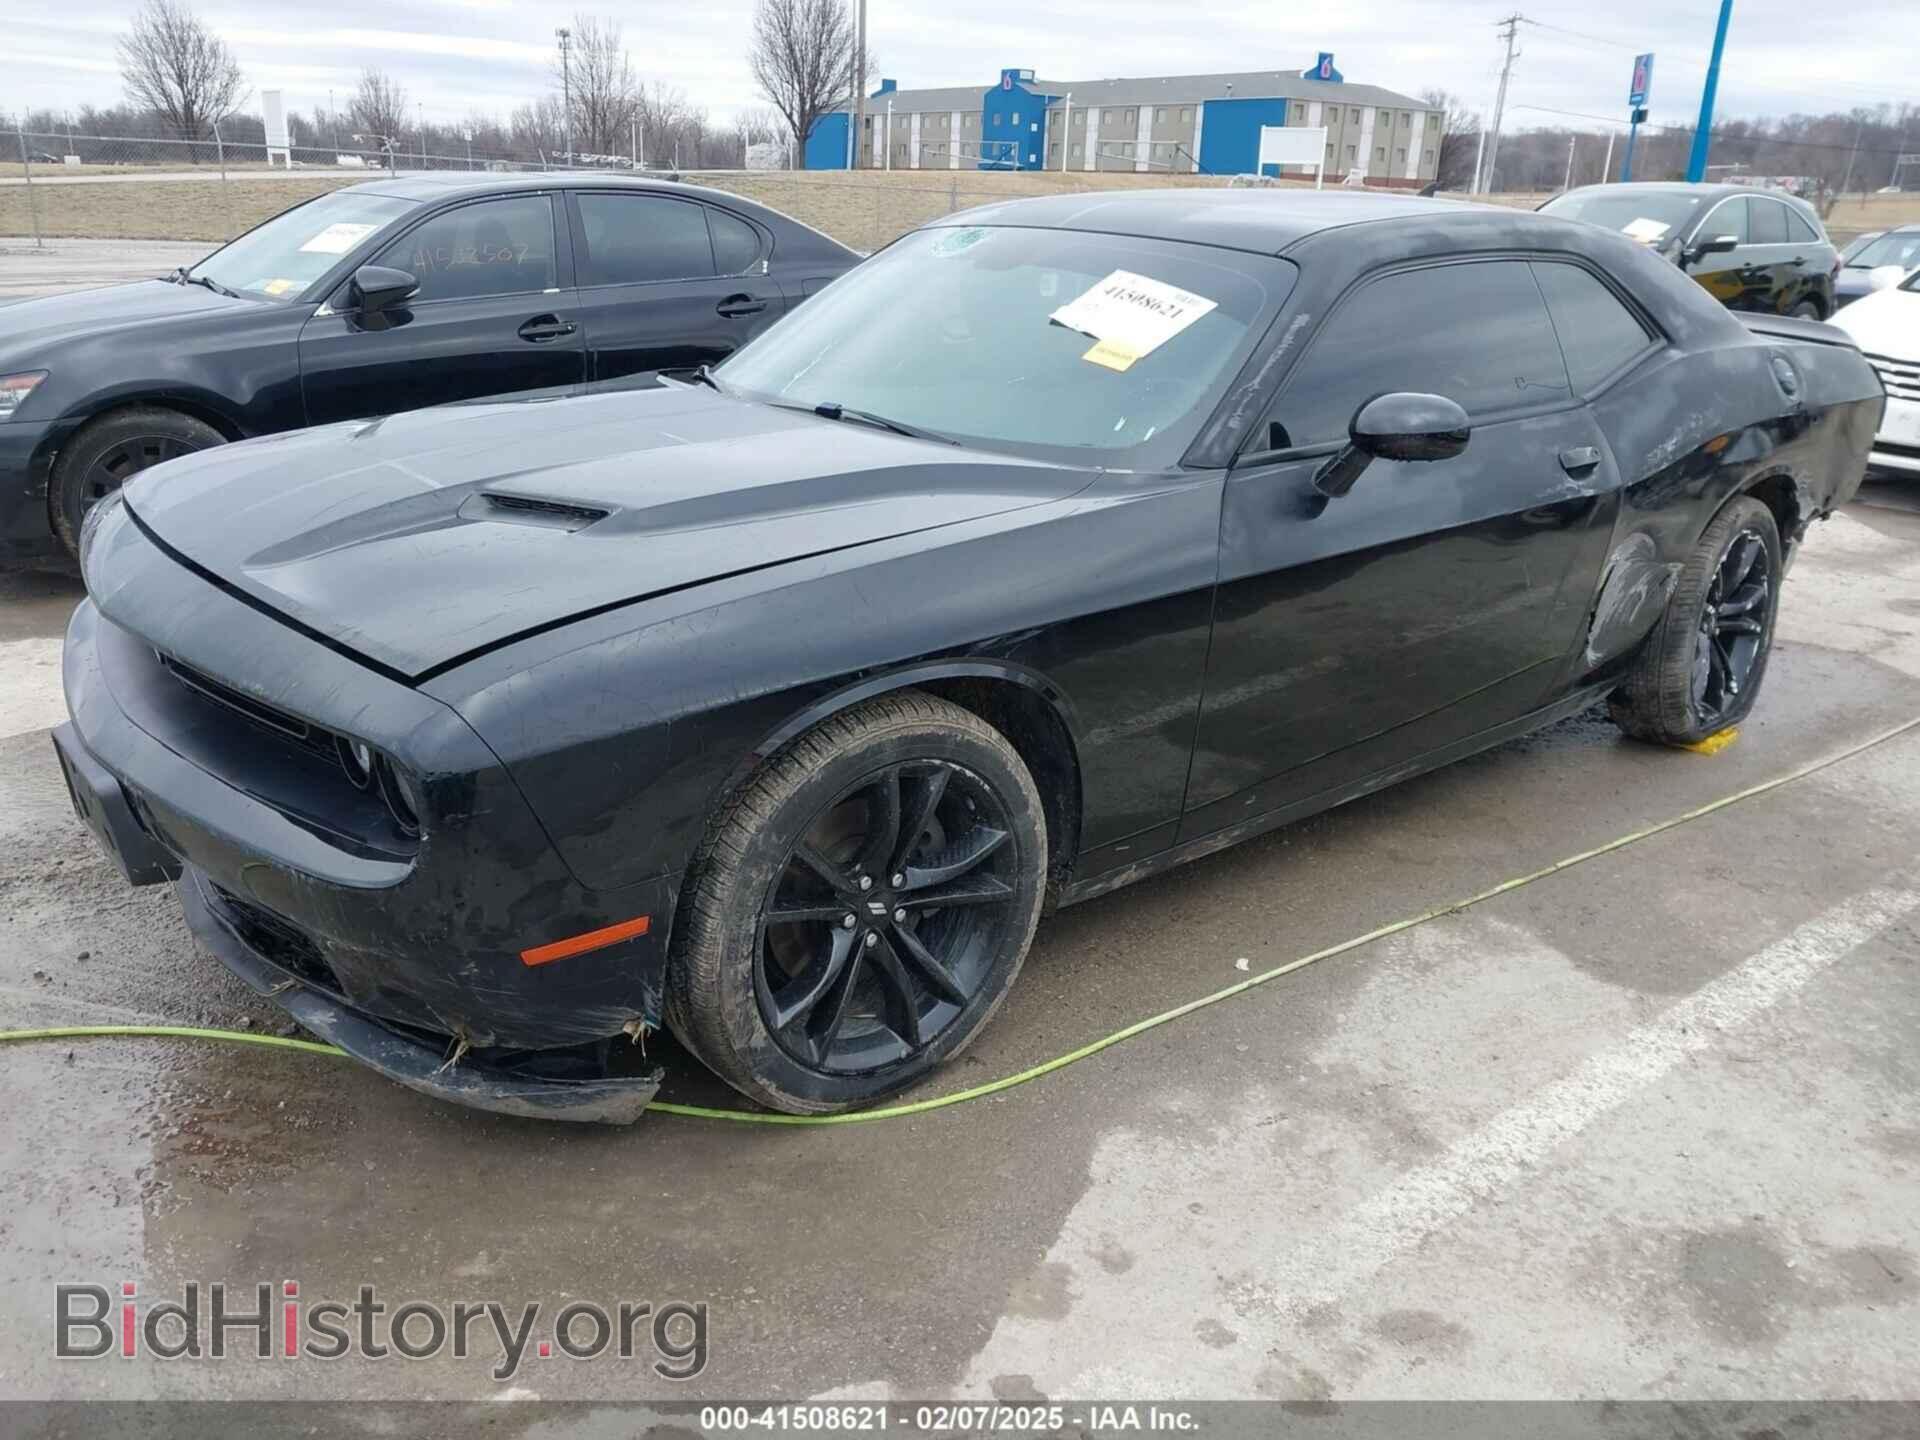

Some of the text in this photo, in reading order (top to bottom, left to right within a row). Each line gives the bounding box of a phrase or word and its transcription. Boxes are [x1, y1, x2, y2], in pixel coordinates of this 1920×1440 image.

[1321, 57, 1330, 78] 6
[1003, 72, 1012, 90] 6
[1104, 286, 1184, 318] 41508621
